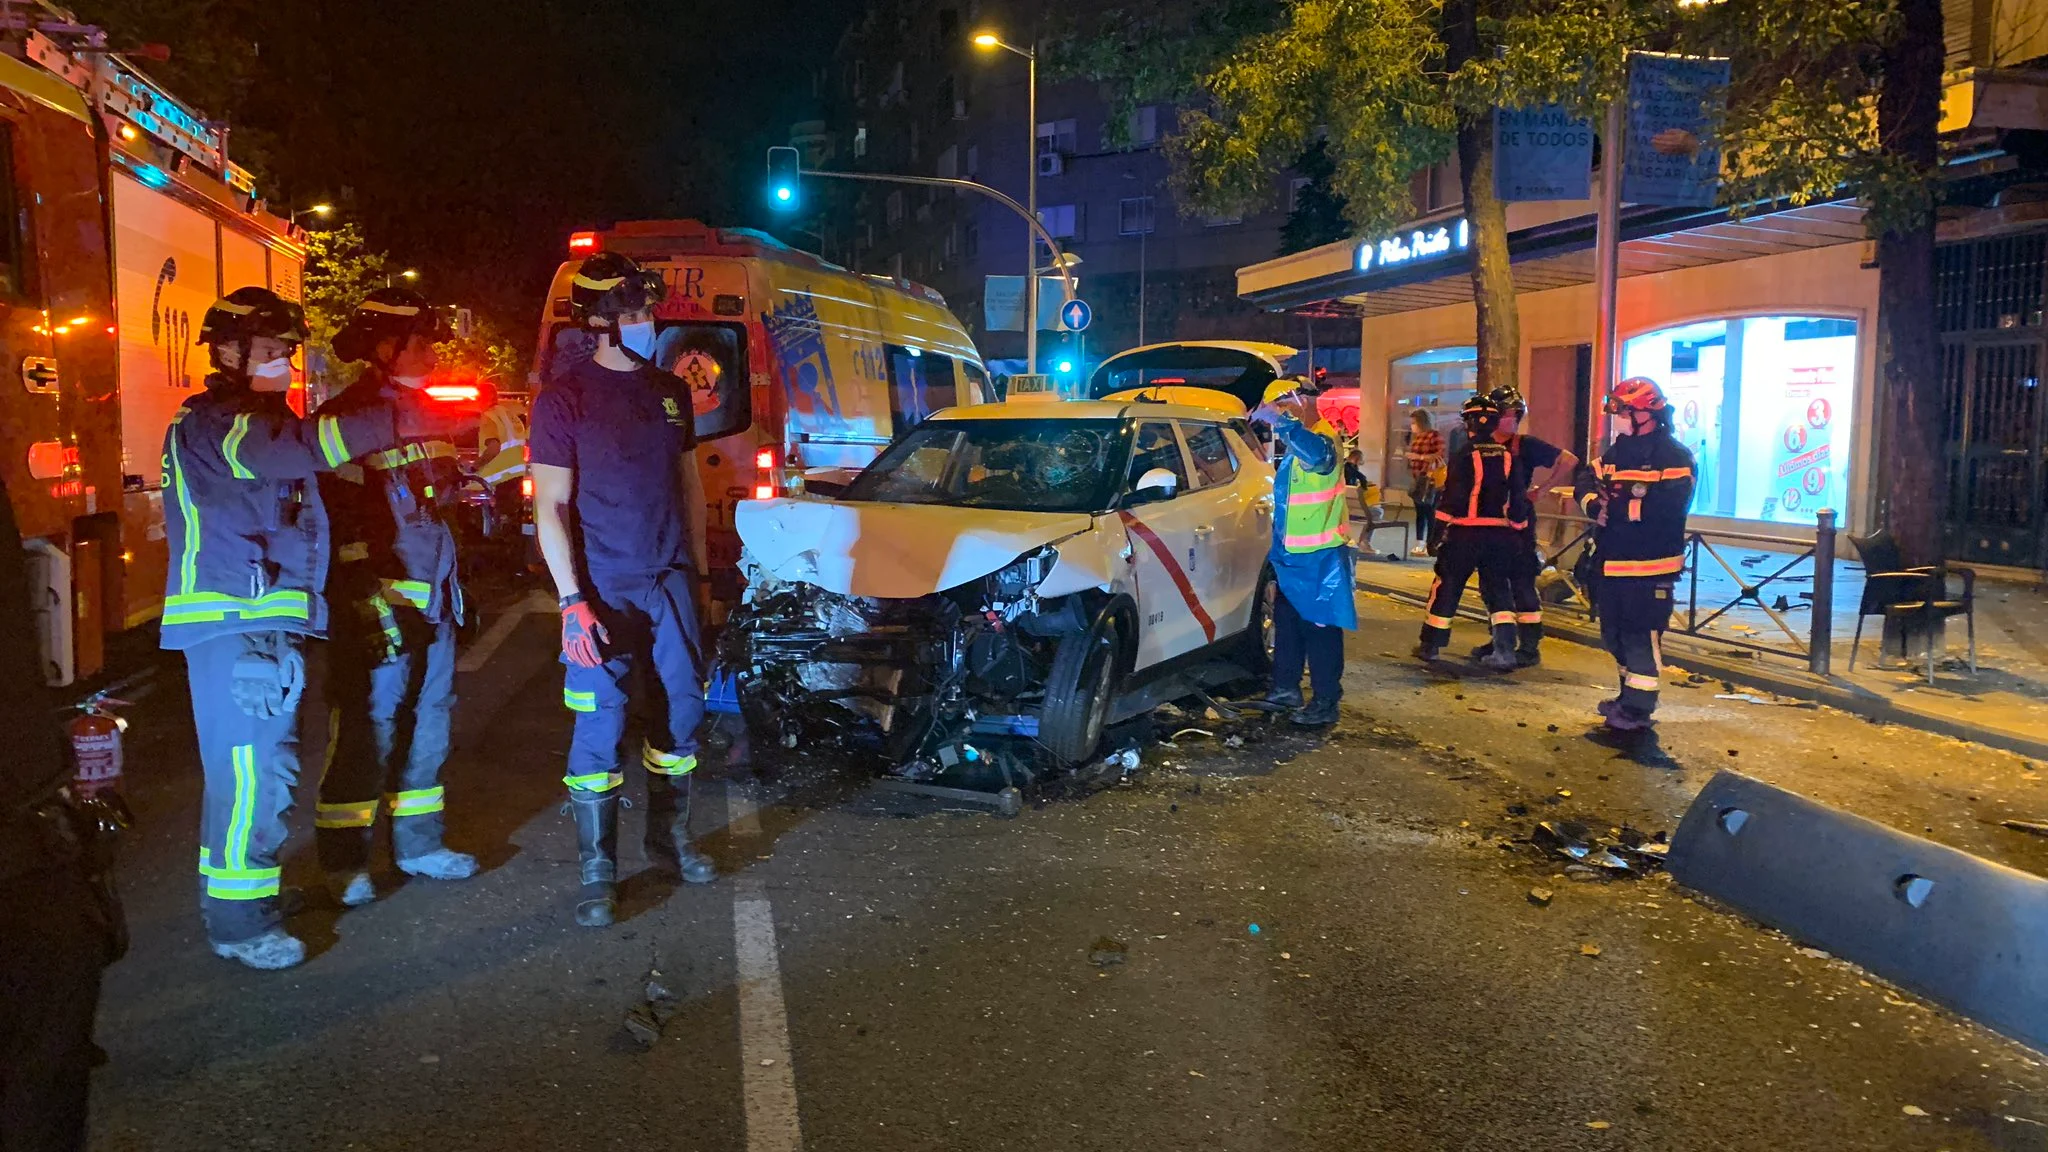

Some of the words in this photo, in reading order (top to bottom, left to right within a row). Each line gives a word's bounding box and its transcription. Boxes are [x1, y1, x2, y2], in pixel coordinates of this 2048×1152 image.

[1500, 131, 1520, 147] DE
[1526, 131, 1589, 147] TODOS
[164, 306, 191, 388] 112
[1018, 377, 1043, 392] TAXI
